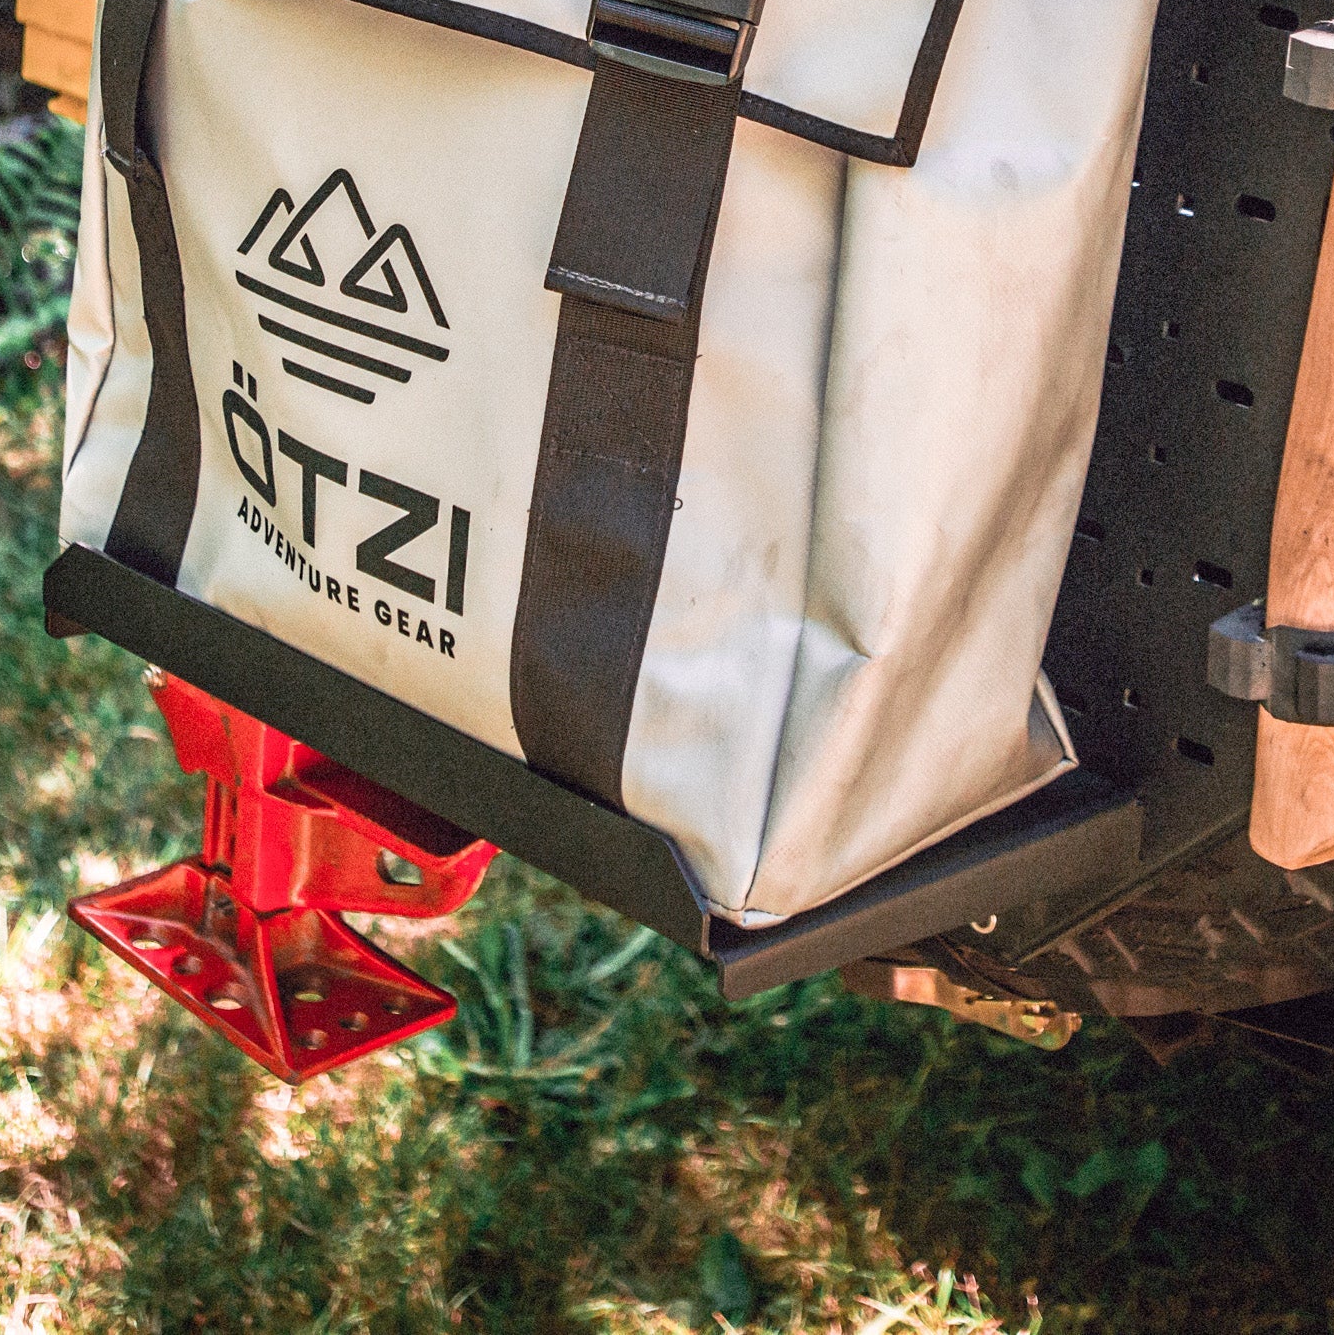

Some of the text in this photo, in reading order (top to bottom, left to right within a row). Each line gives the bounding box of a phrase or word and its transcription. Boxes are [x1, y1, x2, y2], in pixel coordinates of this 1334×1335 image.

[222, 359, 471, 617] ÖTZI
[237, 495, 456, 659] ADVENTURE GEAR
